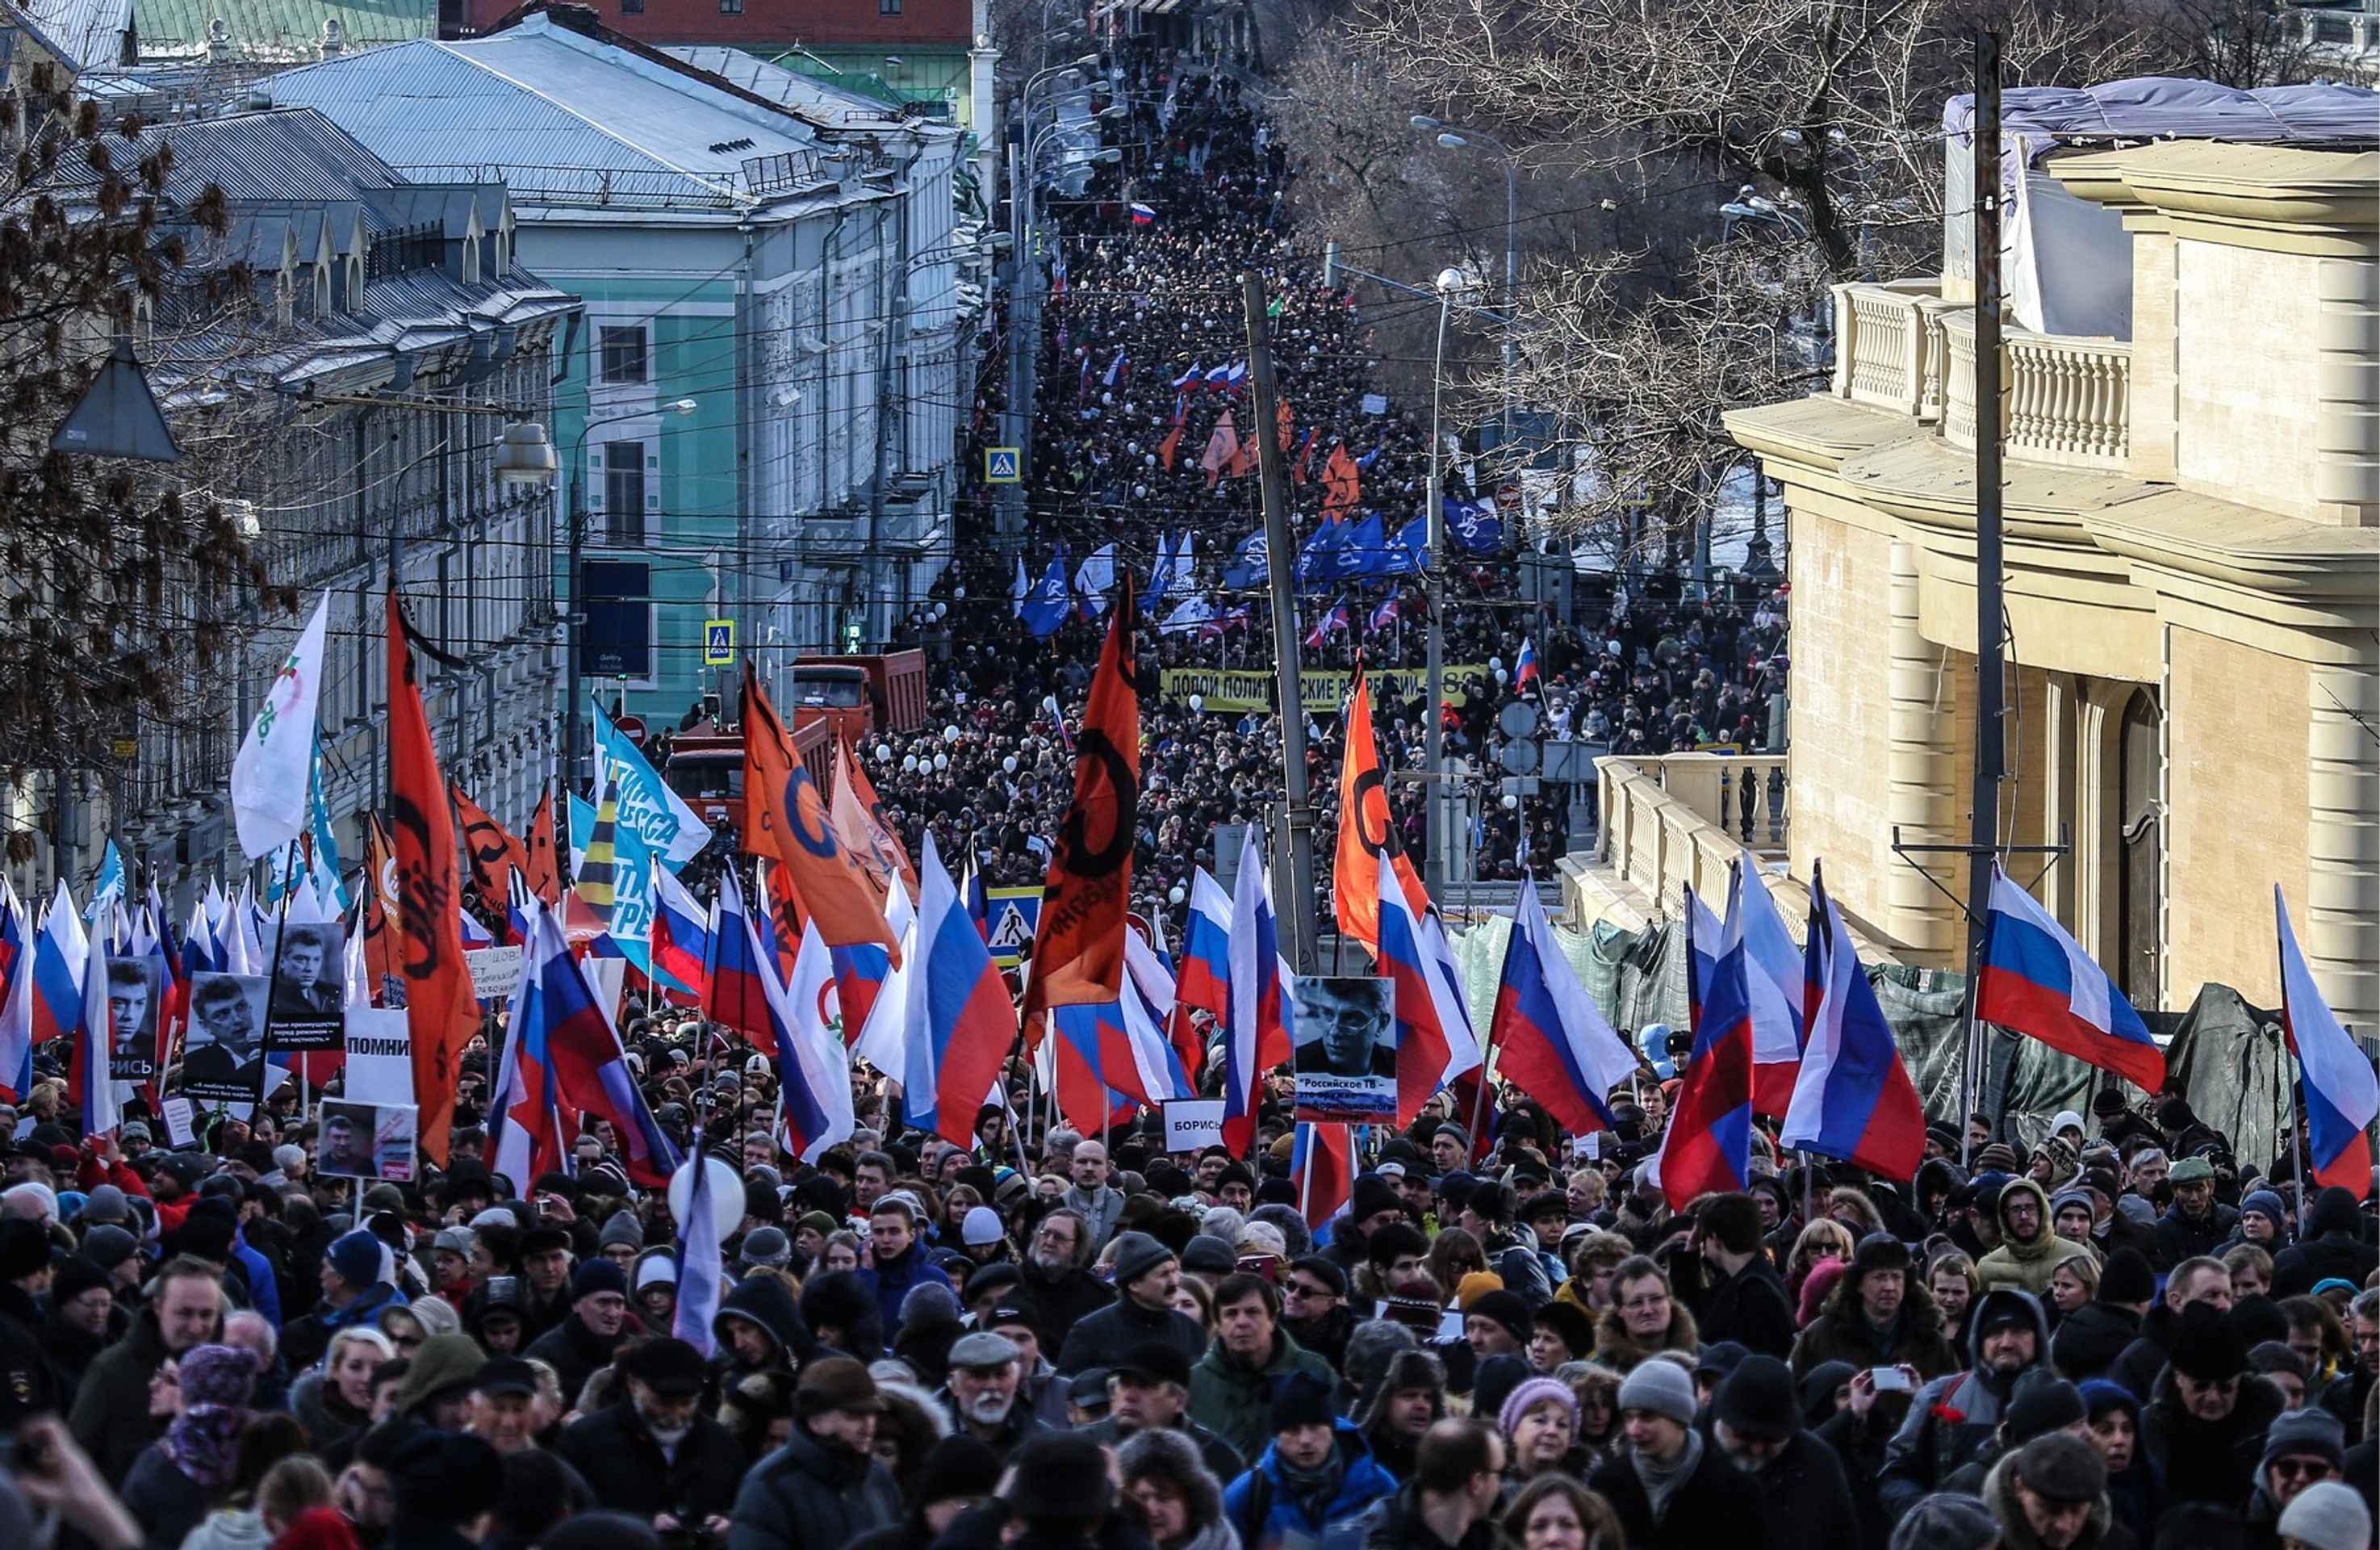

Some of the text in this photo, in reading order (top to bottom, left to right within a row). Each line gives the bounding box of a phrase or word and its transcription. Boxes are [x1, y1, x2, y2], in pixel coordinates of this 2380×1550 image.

[1223, 677, 1334, 701] ПОЛИТСКИЕ
[472, 967, 487, 977] ЕТ
[347, 1037, 410, 1057] ПОМНИ
[109, 1059, 152, 1075] РИСЬ
[1364, 1079, 1377, 1089] ТВ
[1174, 1121, 1222, 1131] БОРИСЬ
